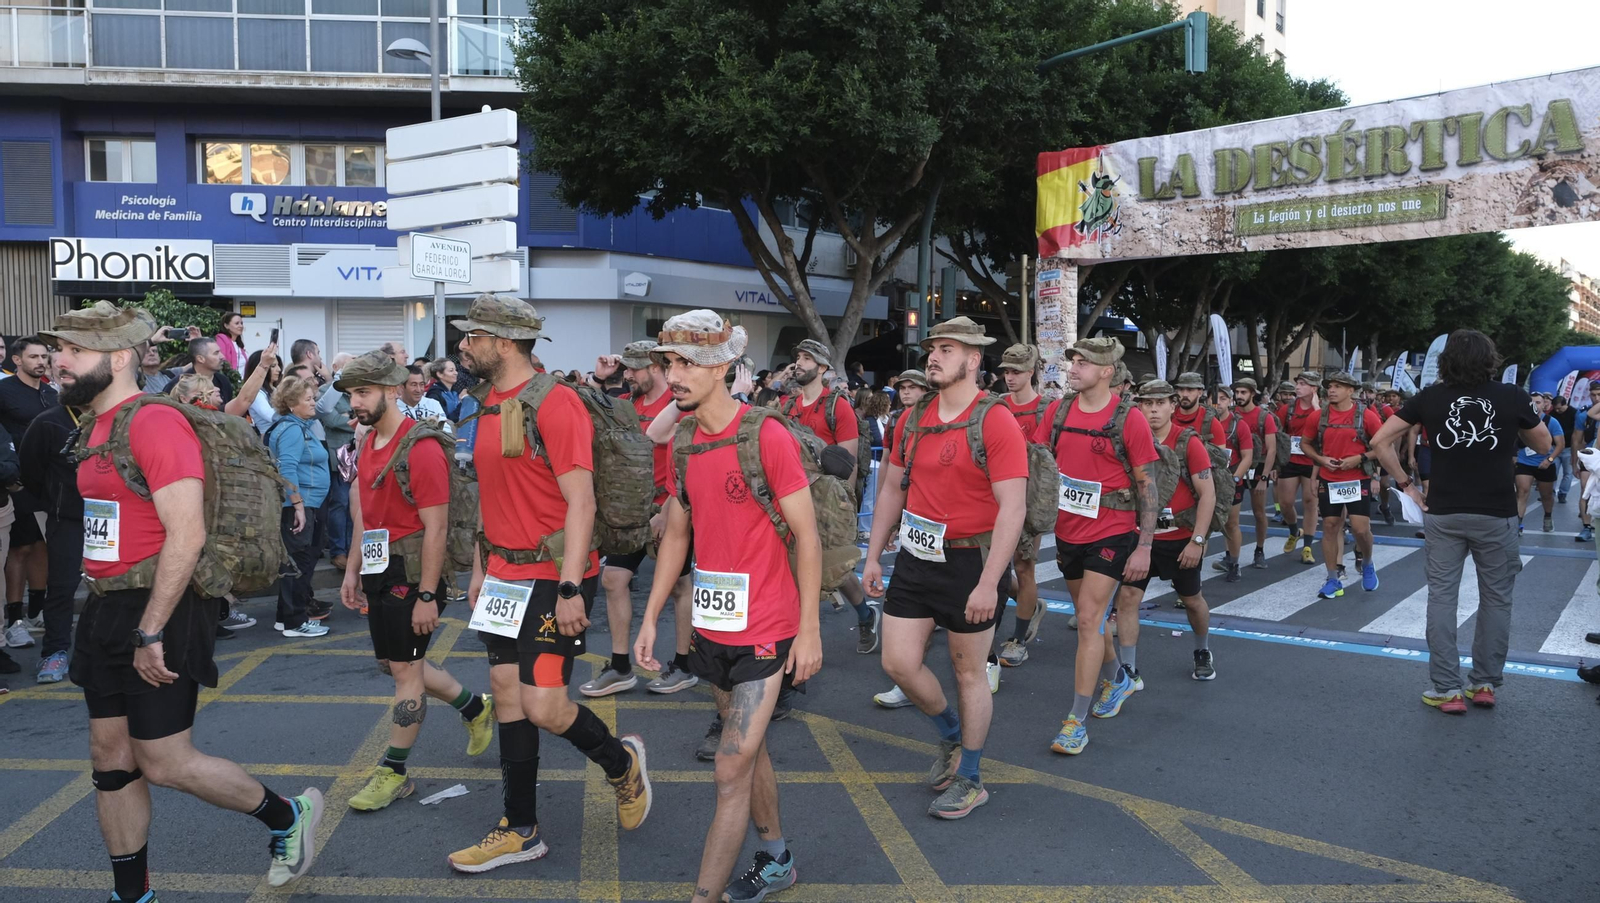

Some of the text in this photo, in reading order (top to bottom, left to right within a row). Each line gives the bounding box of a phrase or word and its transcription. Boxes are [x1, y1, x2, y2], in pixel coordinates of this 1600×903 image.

[1138, 98, 1585, 200] LA DESÉRTICA
[121, 195, 176, 208] Psicología
[272, 193, 388, 217] Háblame
[95, 210, 144, 220] Medicina
[147, 210, 161, 220] de
[1253, 198, 1421, 224] La Legión y el desierto nos une
[272, 217, 387, 229] Centro Interdisciplinar
[430, 242, 468, 254] AVENIDA
[51, 239, 210, 280] Phonika
[424, 252, 459, 266] FEDERICO
[416, 263, 467, 279] GARCÍA LORCA
[1063, 487, 1093, 505] 4977
[1336, 486, 1357, 496] 4960
[907, 527, 936, 550] 4962
[363, 542, 383, 559] 4968
[694, 587, 736, 611] 4958
[485, 597, 518, 619] 4951
